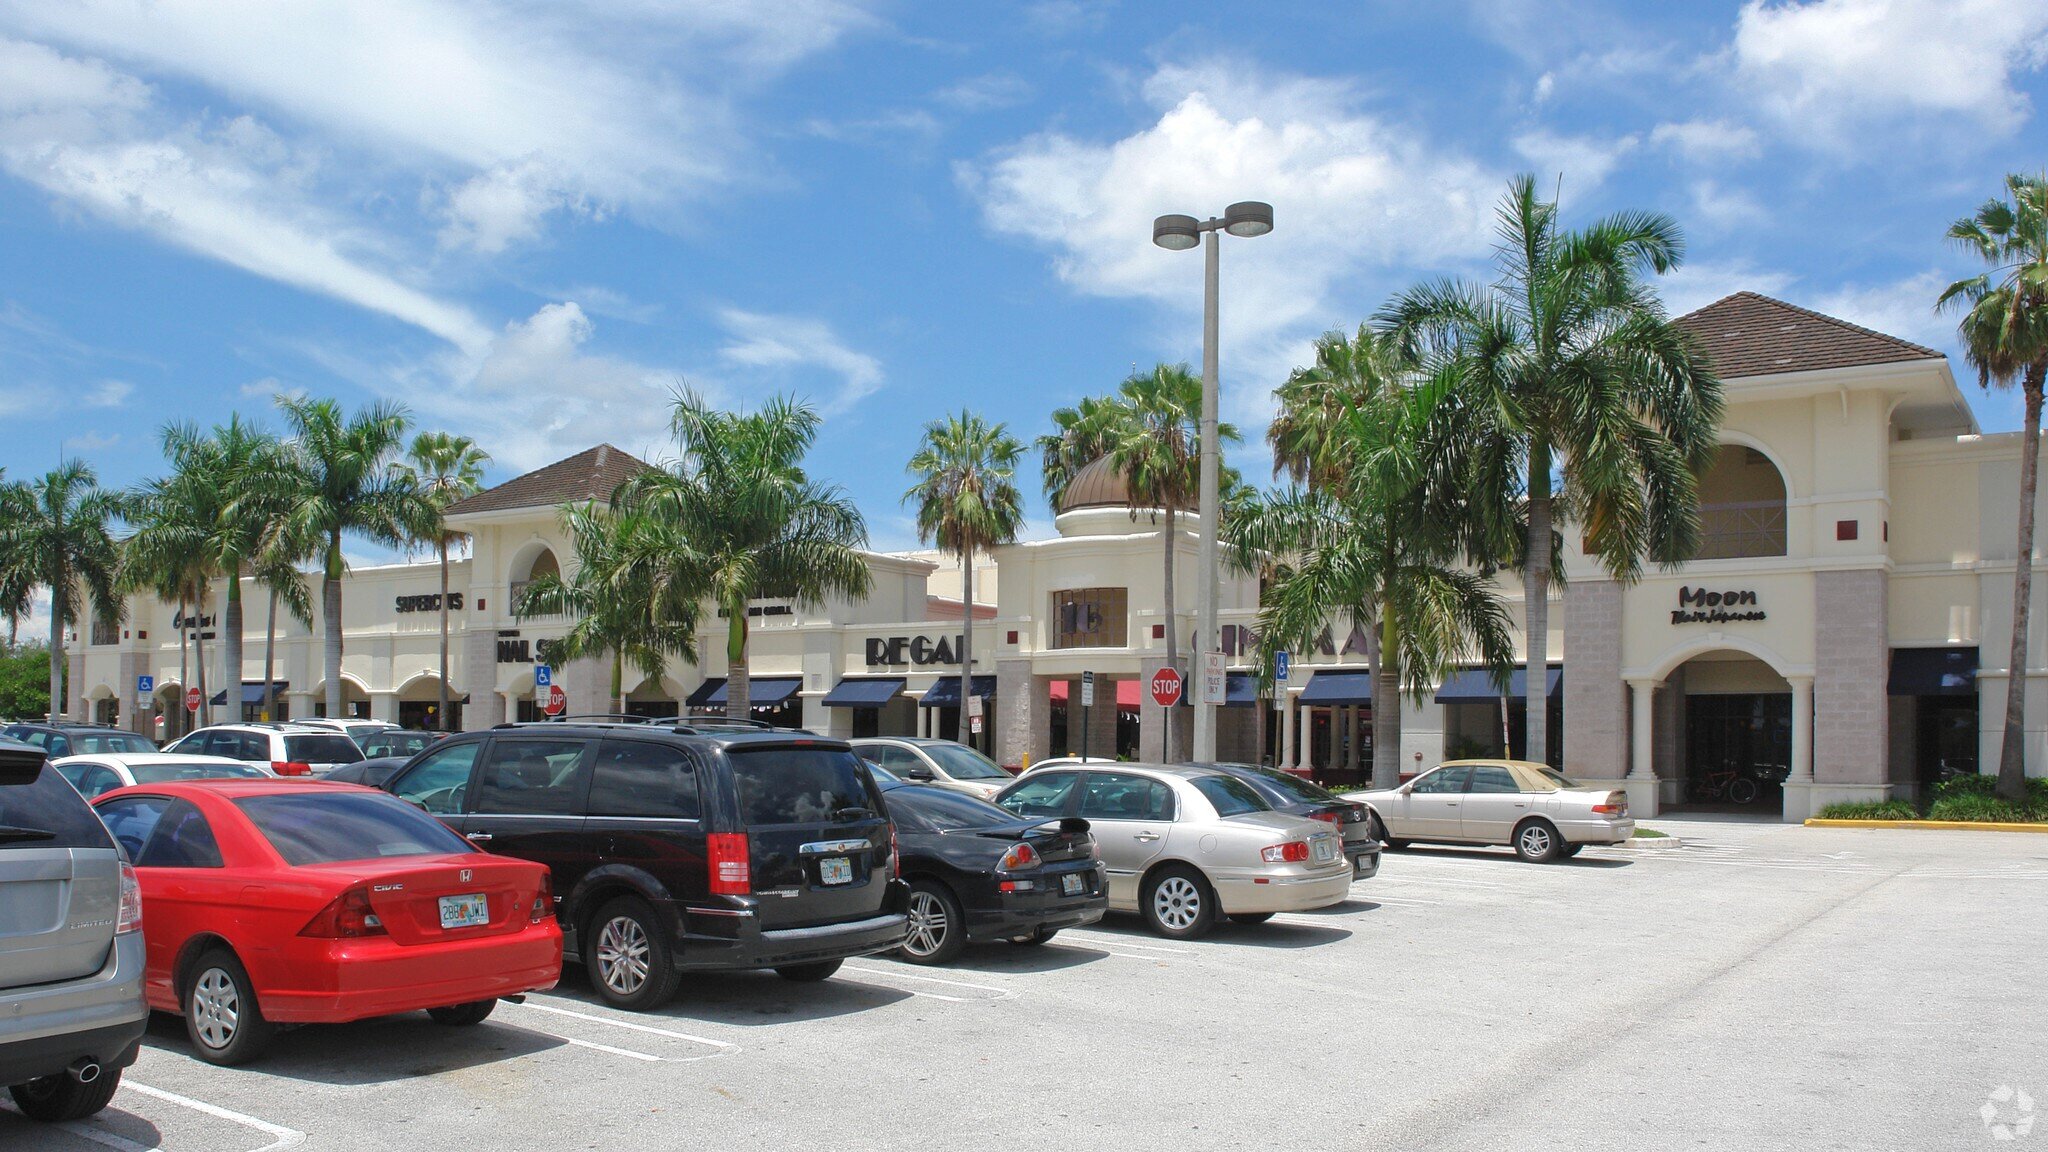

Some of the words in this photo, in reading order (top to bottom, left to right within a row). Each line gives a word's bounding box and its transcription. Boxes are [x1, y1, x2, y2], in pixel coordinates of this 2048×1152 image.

[1679, 586, 1757, 607] Moon
[866, 635, 979, 666] REGAL
[1209, 655, 1218, 667] NO
[1153, 679, 1180, 695] STOP
[187, 694, 200, 704] STOP
[374, 884, 403, 892] CIVIC
[70, 920, 112, 929] LIMITED
